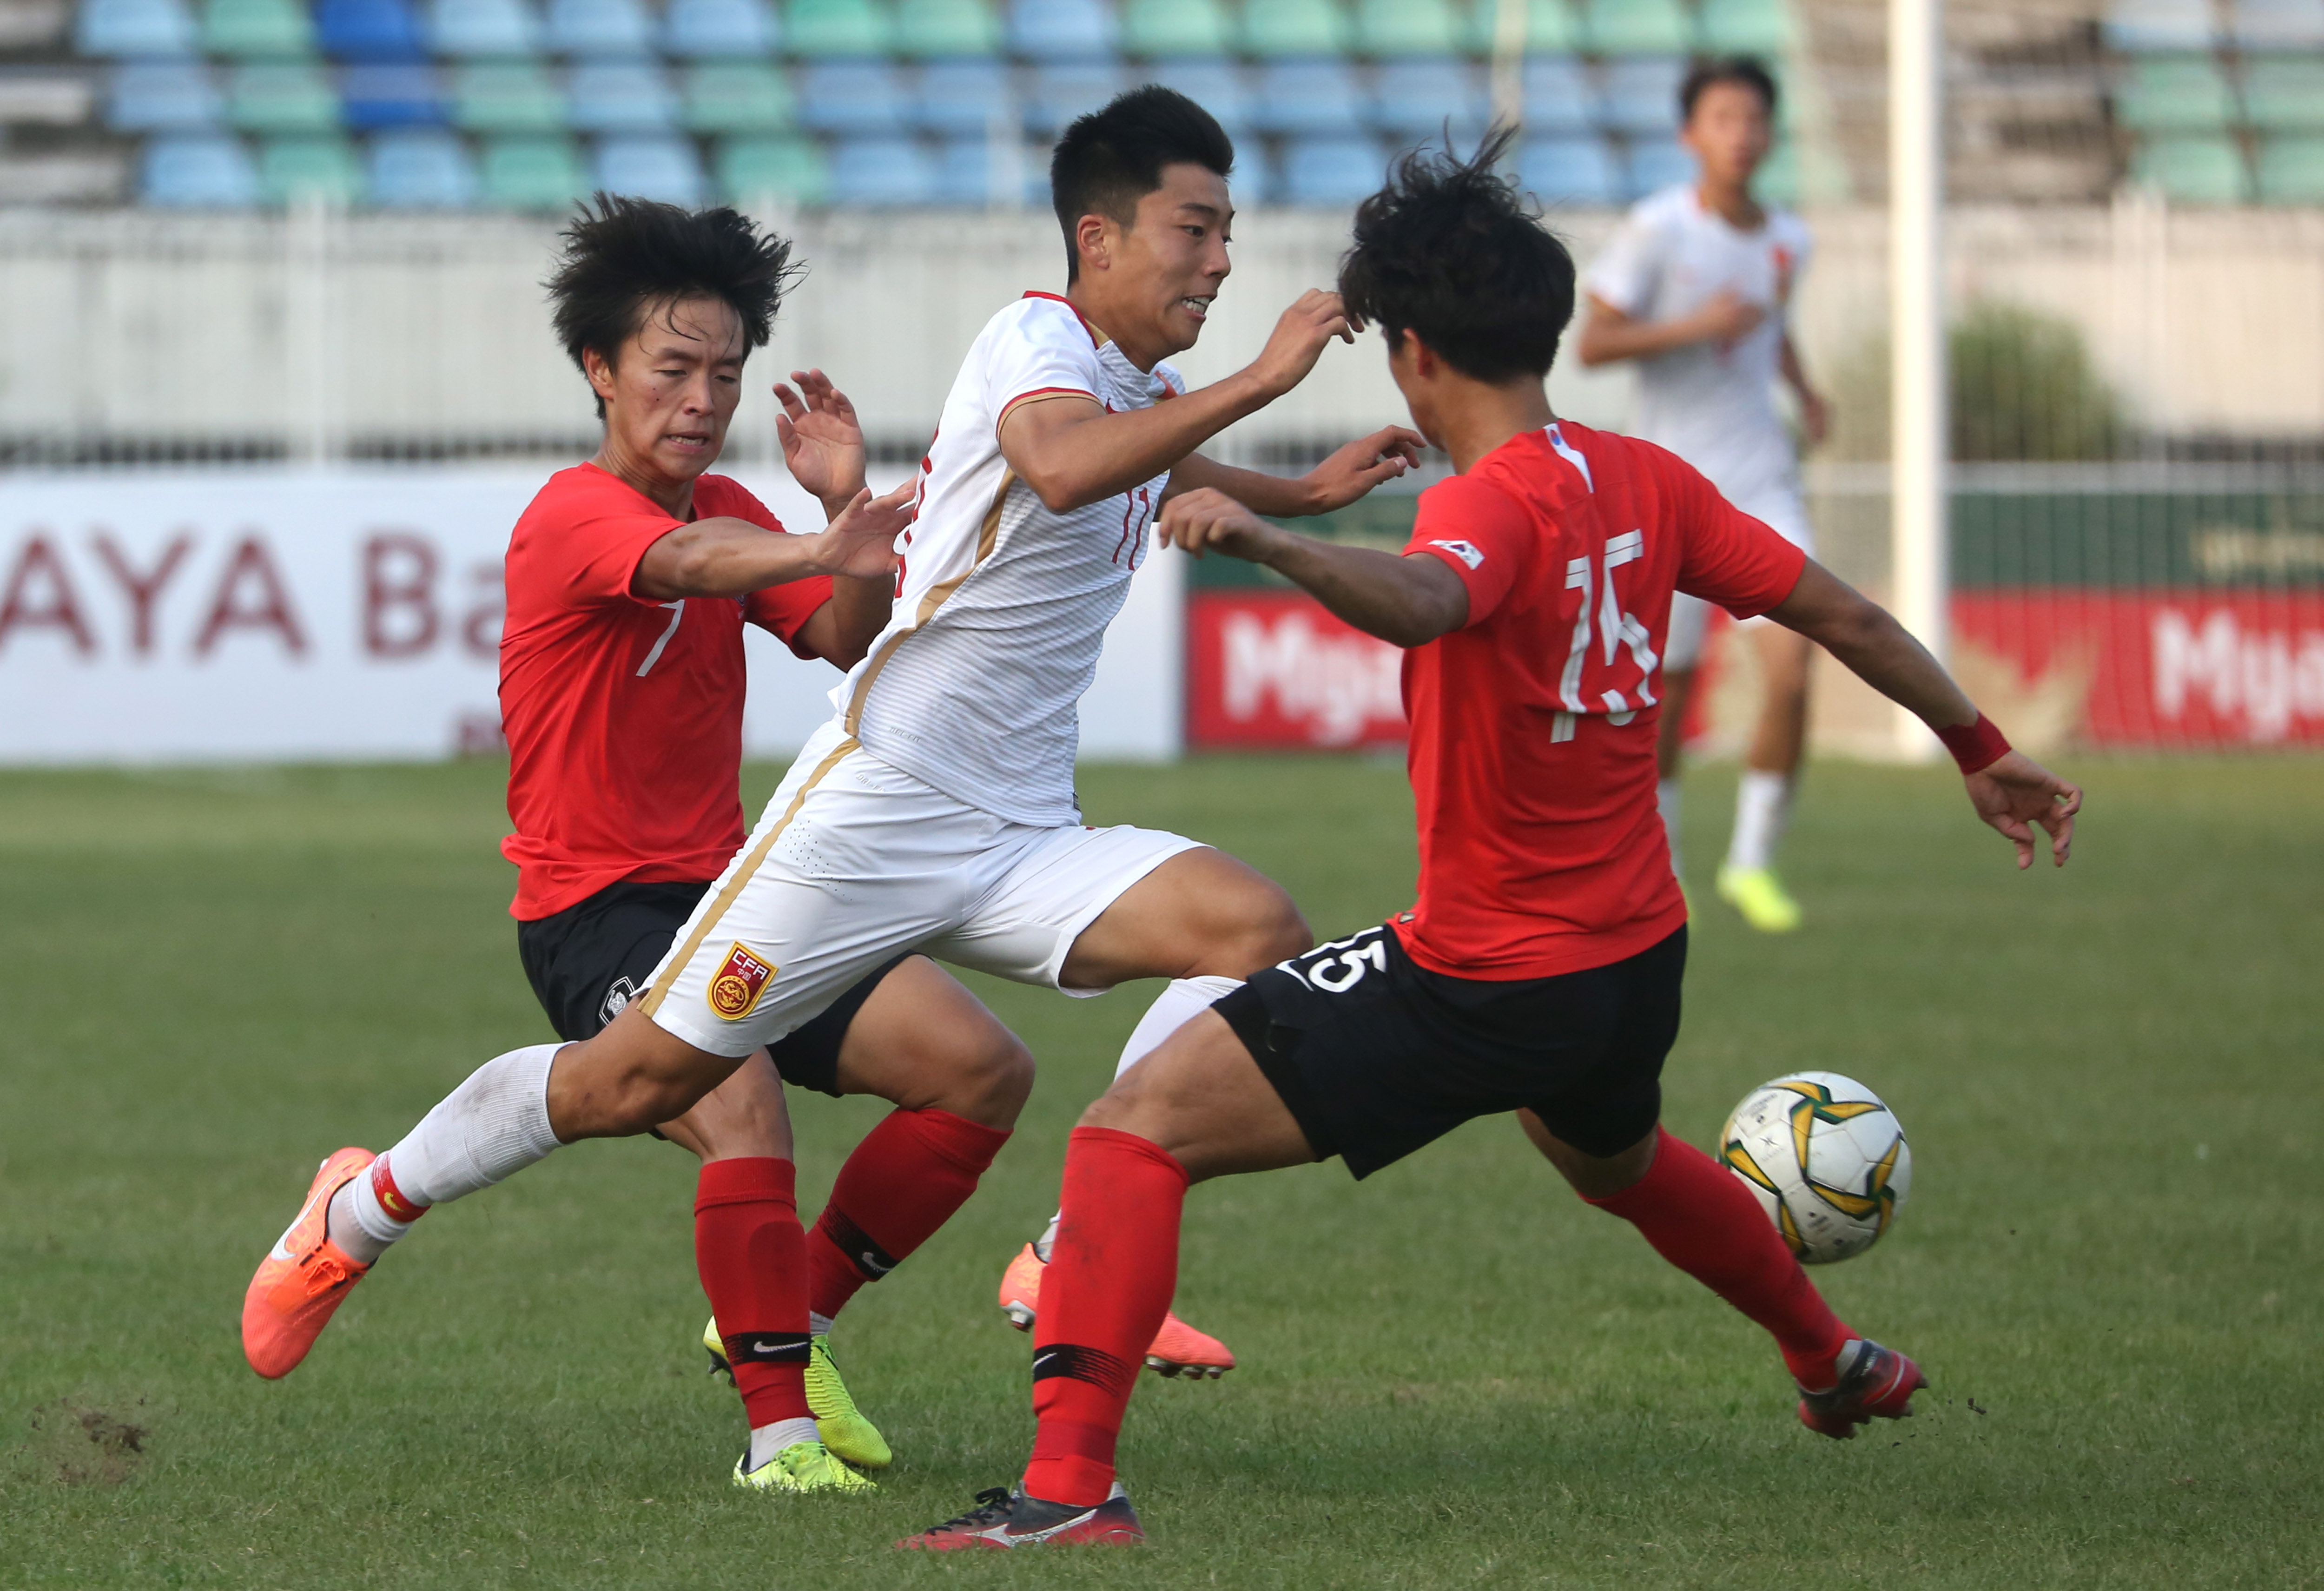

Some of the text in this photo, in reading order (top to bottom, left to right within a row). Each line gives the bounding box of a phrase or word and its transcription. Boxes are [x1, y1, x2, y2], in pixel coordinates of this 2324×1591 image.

[1111, 487, 1149, 571] 11
[0, 529, 312, 660] AYA
[1550, 528, 1658, 744] 15
[636, 599, 685, 677] 7
[732, 950, 768, 980] CFA
